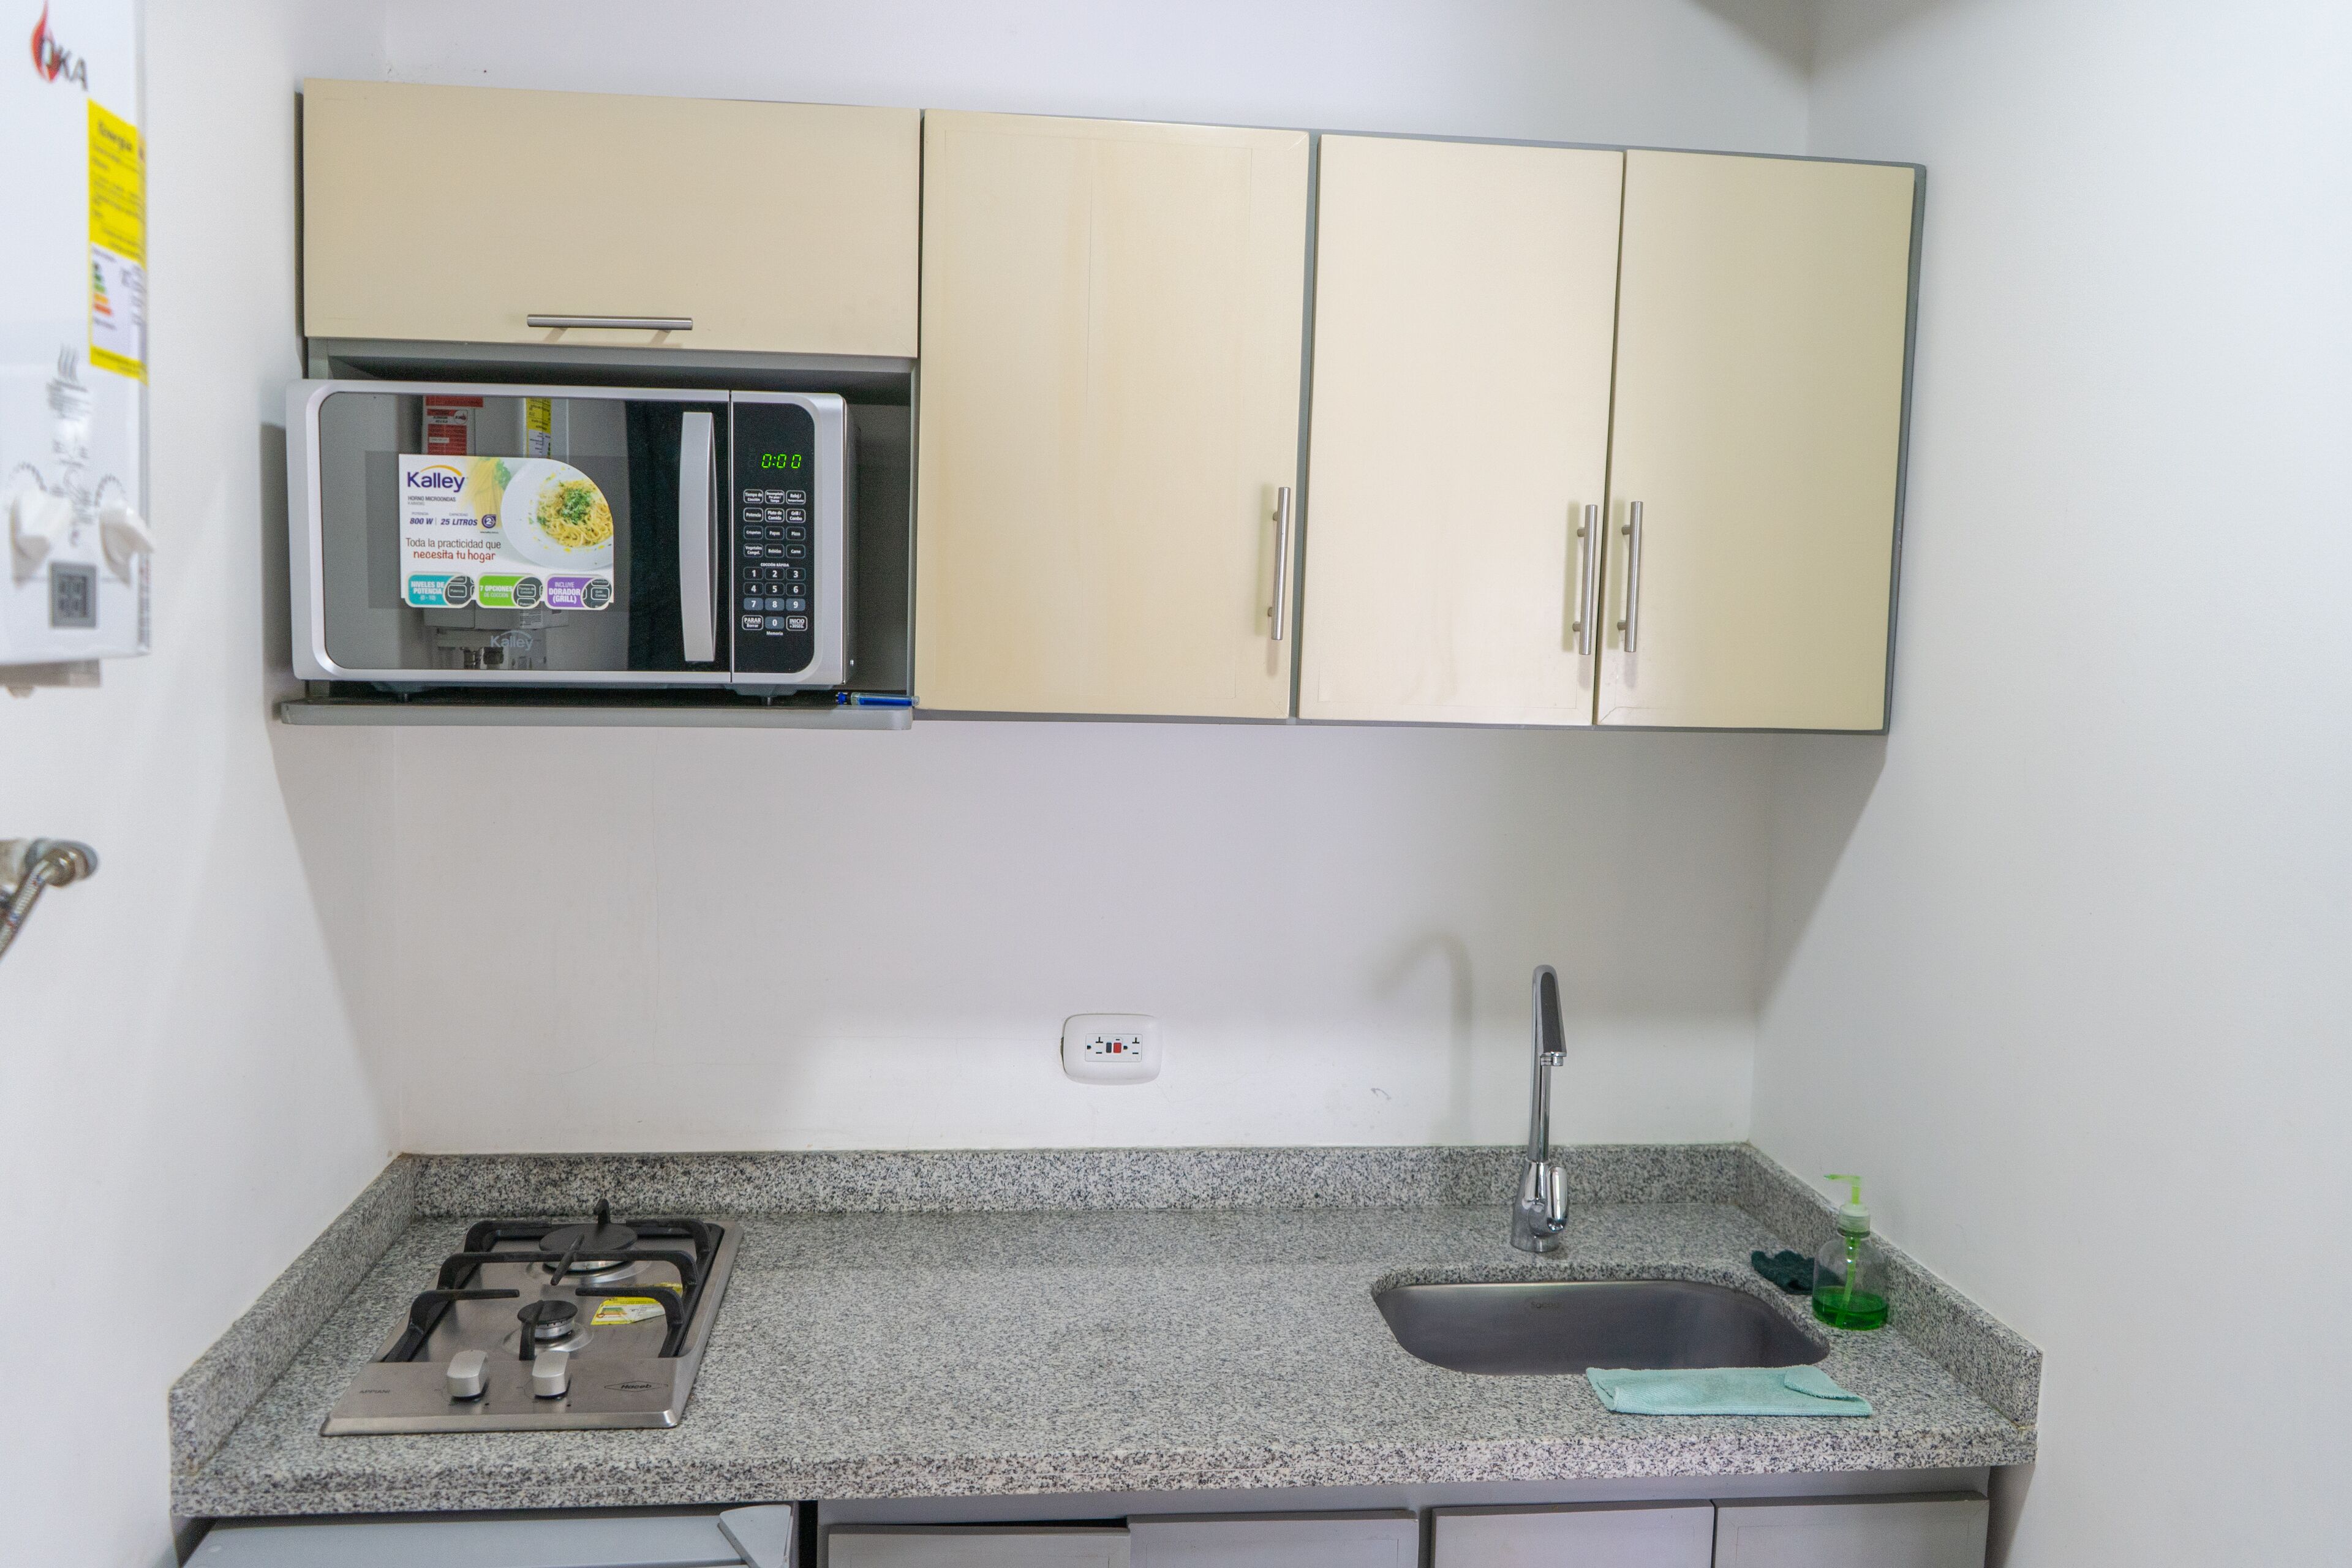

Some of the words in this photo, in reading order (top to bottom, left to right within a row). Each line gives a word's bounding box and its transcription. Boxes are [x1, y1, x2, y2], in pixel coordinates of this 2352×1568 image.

[761, 454, 802, 469] 0:00
[407, 472, 465, 492] Kalley
[405, 538, 426, 547] Toda
[428, 538, 435, 547] la
[437, 538, 483, 549] practicidad
[486, 541, 501, 550] que
[413, 550, 453, 559] necesita
[456, 551, 466, 559] tu
[468, 549, 496, 563] hogar
[552, 595, 577, 604] (GRILL)
[490, 635, 533, 650] Kalley
